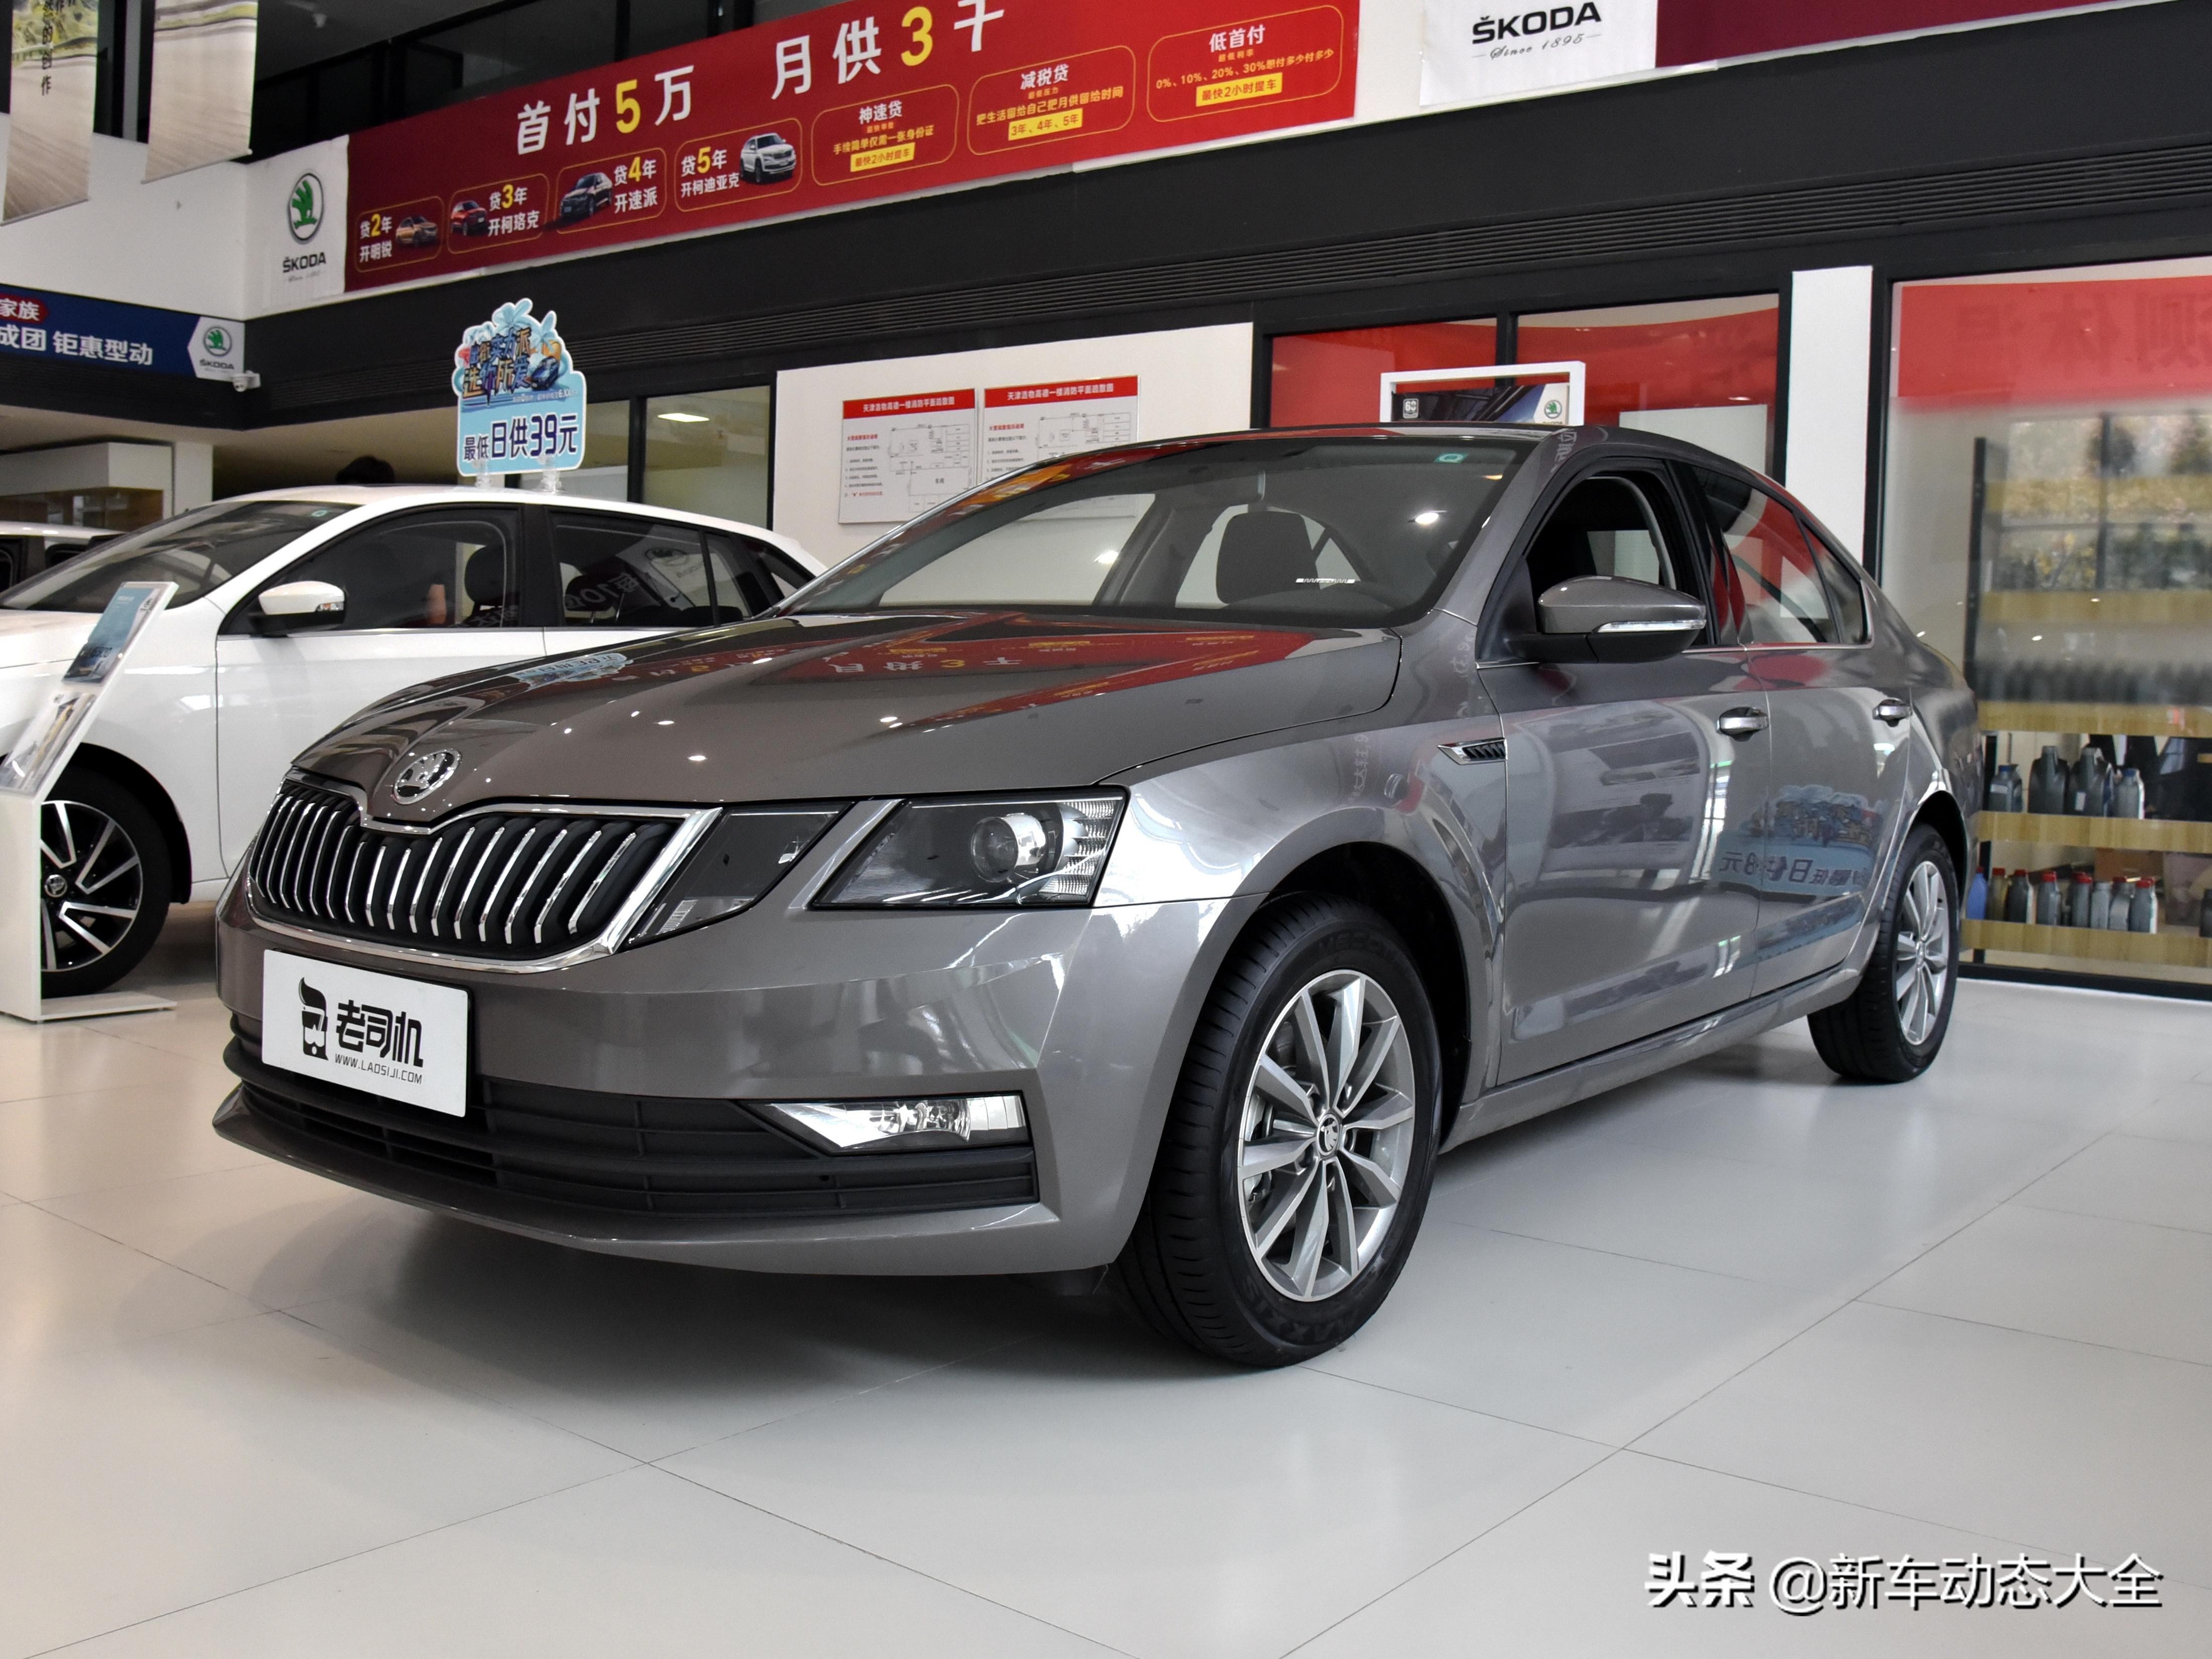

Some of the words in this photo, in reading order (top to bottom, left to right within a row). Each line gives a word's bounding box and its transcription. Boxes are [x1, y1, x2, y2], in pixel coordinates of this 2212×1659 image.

[1472, 2, 1602, 45] ŠKODA
[1209, 24, 1265, 53] 低首付
[1490, 45, 1532, 60] Since
[1541, 33, 1585, 50] 1895
[517, 65, 695, 155] 首付5万
[771, 0, 1005, 100] 月供3千
[1020, 63, 1069, 90] 减税贷
[1202, 78, 1277, 101] 最快2小时提车
[858, 100, 902, 125] 神速贷
[1010, 114, 1079, 136] 3年、4年、5年
[833, 125, 935, 155] 手续简单仅需一张身份证
[681, 146, 727, 177] 贷5年
[855, 148, 910, 167] 最快2小时提车
[614, 156, 657, 187] 贷4年
[681, 172, 740, 198] 开柯迪亚克
[489, 184, 528, 212] 贷3年
[614, 186, 658, 214] 开速派
[359, 213, 393, 239] 贷2年
[488, 210, 540, 237] 开柯珞克
[283, 251, 326, 273] ŠKODA
[359, 240, 392, 263] 开明锐
[0, 298, 40, 322] 家族
[0, 324, 47, 351] 成团
[53, 330, 153, 366] 钜惠型动
[464, 413, 578, 460] 最低日供39元
[336, 999, 424, 1068] 老司机
[335, 1053, 422, 1085] WWW.LAOSIJI.COM
